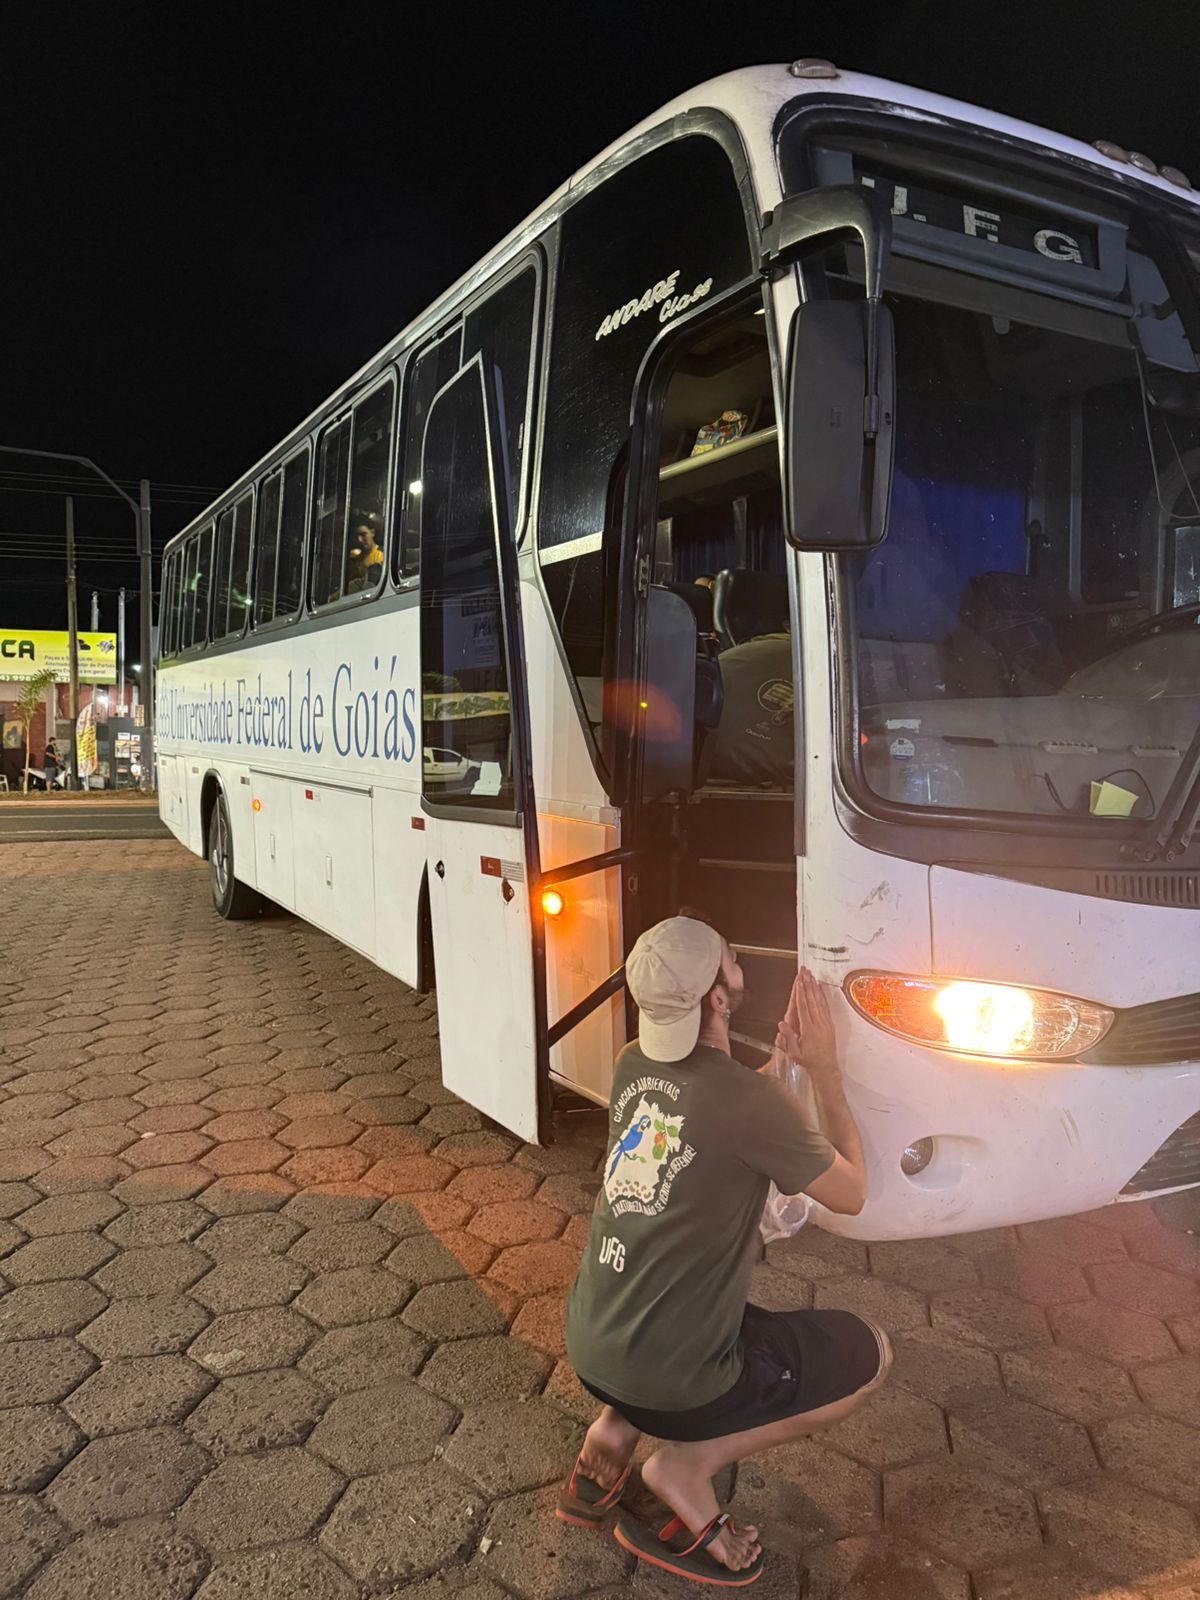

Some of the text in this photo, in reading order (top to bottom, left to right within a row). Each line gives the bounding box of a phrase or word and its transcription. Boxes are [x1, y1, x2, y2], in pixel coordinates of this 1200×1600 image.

[1032, 228, 1084, 264] G
[595, 269, 681, 342] ANDARE
[659, 277, 714, 323] Class
[170, 678, 233, 745] Universidade
[236, 667, 294, 751] Federal
[299, 667, 325, 755] de
[332, 655, 417, 764] Goiás
[613, 1076, 681, 1123] CIÊNCIAS AMBIENTAIS
[614, 1199, 643, 1216] NATUREZA
[654, 1199, 666, 1213] SE
[665, 1167, 676, 1182] SE
[598, 1235, 626, 1273] UFG
